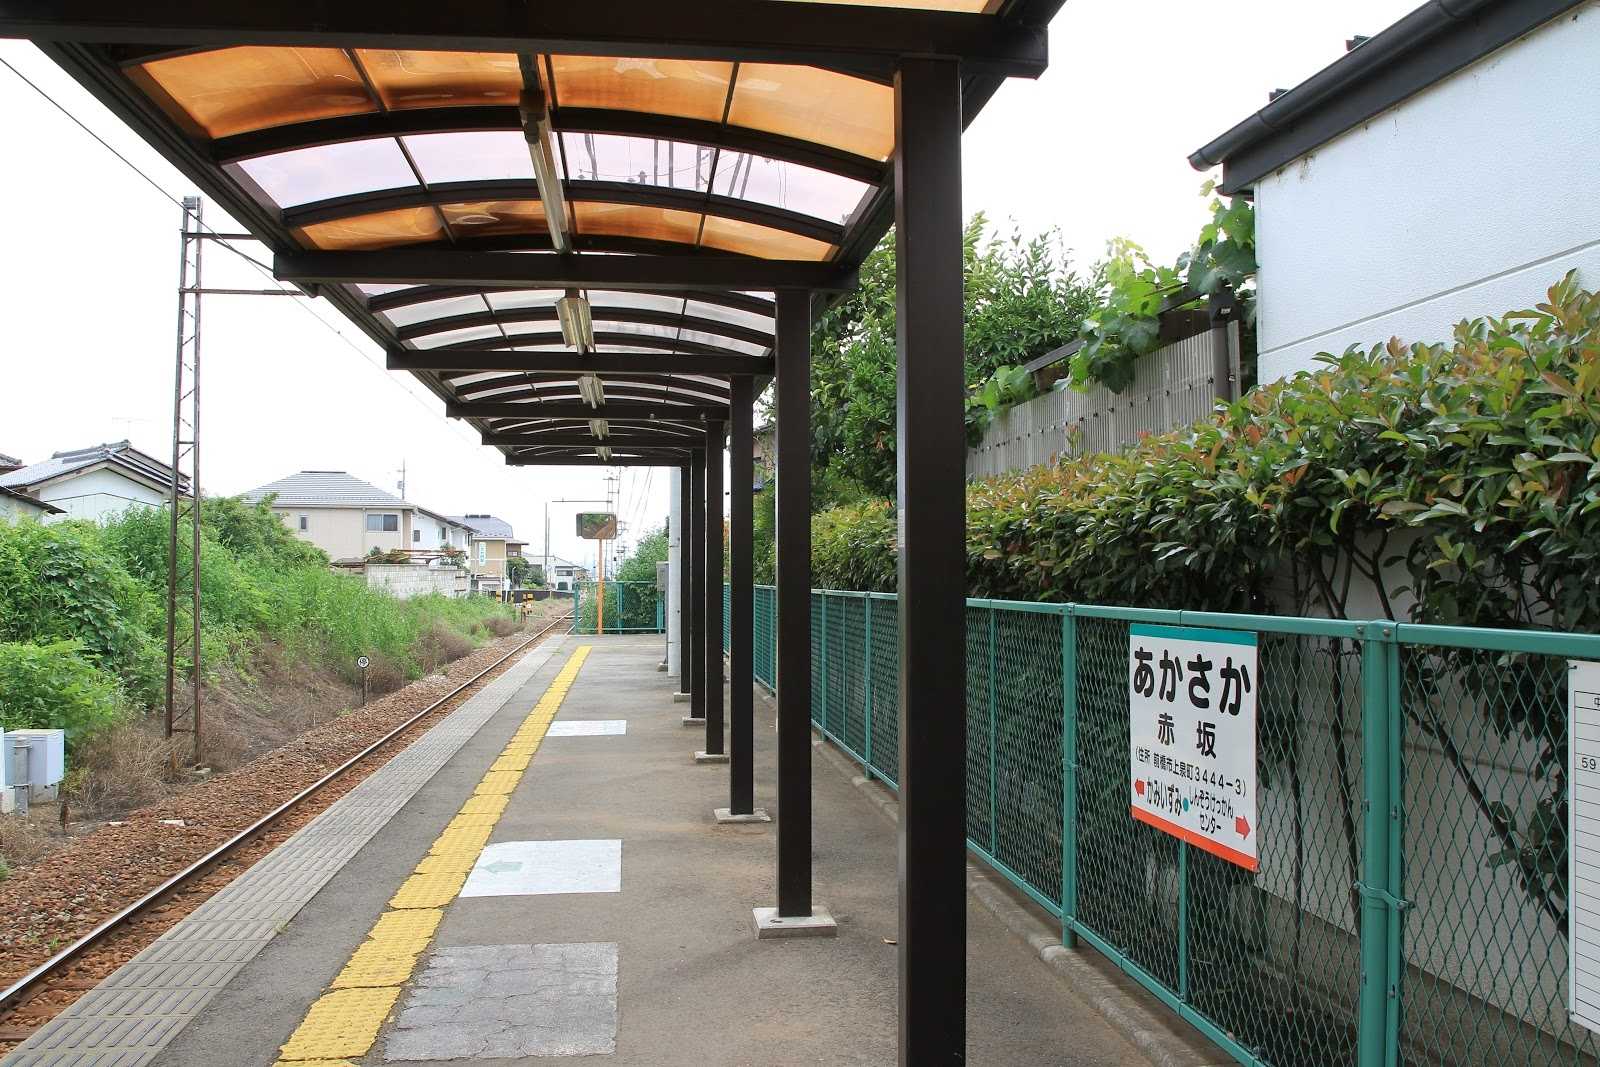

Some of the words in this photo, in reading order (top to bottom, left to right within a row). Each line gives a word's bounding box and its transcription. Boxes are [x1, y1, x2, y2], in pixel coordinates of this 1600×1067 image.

[1133, 646, 1251, 716] あかさか
[1581, 757, 1596, 770] 59
[1147, 779, 1182, 817] かみいずみ
[1200, 814, 1222, 835] センター
